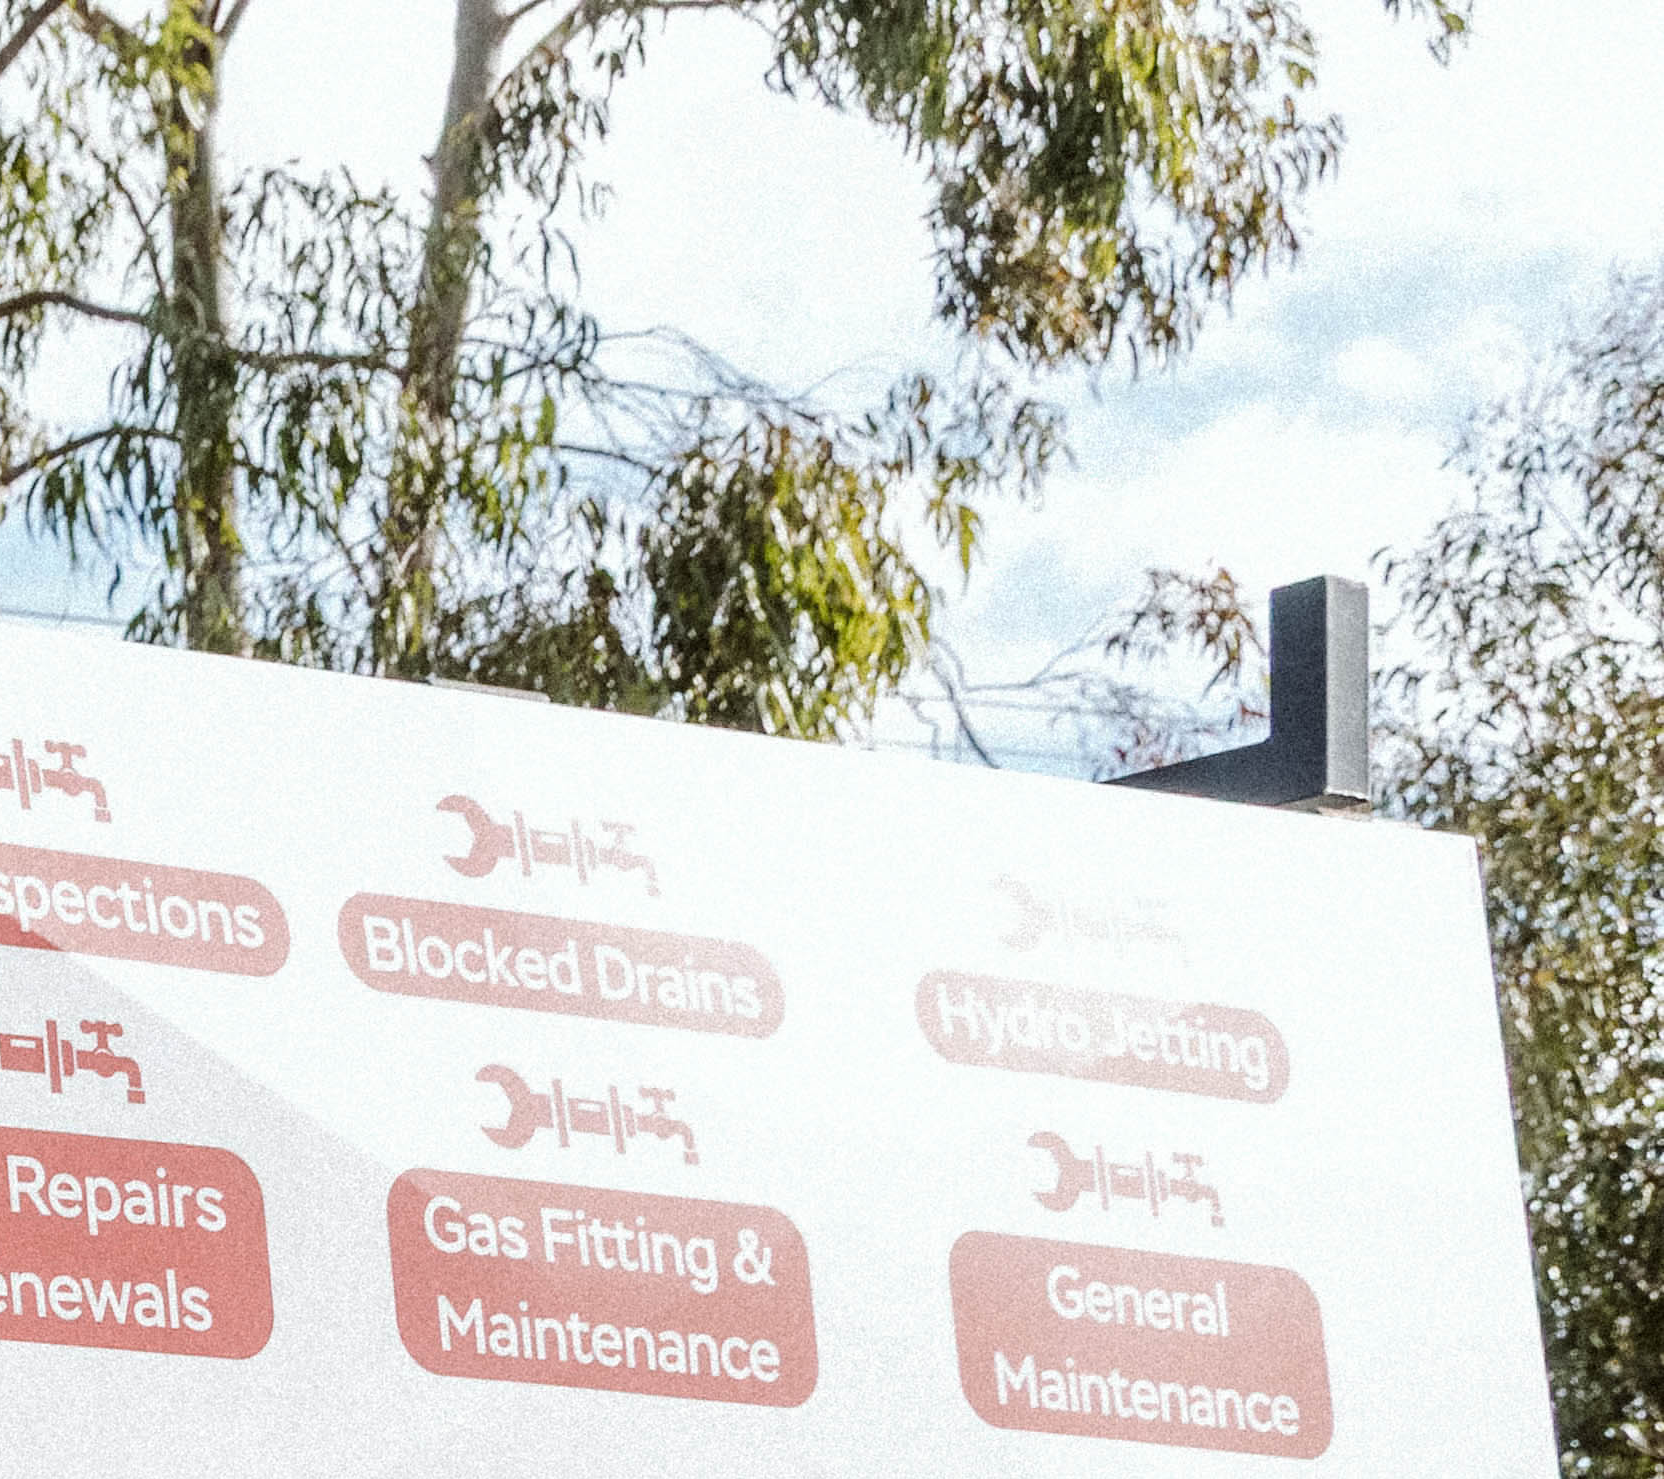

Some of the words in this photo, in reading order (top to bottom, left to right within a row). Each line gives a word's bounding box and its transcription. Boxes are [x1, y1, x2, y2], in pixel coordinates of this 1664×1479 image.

[364, 916, 578, 994] Blocked
[597, 944, 759, 1018] Drains
[937, 983, 1087, 1059] Hydro
[1101, 1008, 1270, 1089] Jetting
[8, 1155, 227, 1235] Repairs
[425, 1196, 528, 1259] Gas
[541, 1209, 717, 1294] Fitting
[733, 1229, 773, 1285] &
[438, 1297, 780, 1380] Maintenance
[1048, 1264, 1228, 1336] General
[994, 1353, 1300, 1435] Maintenance
